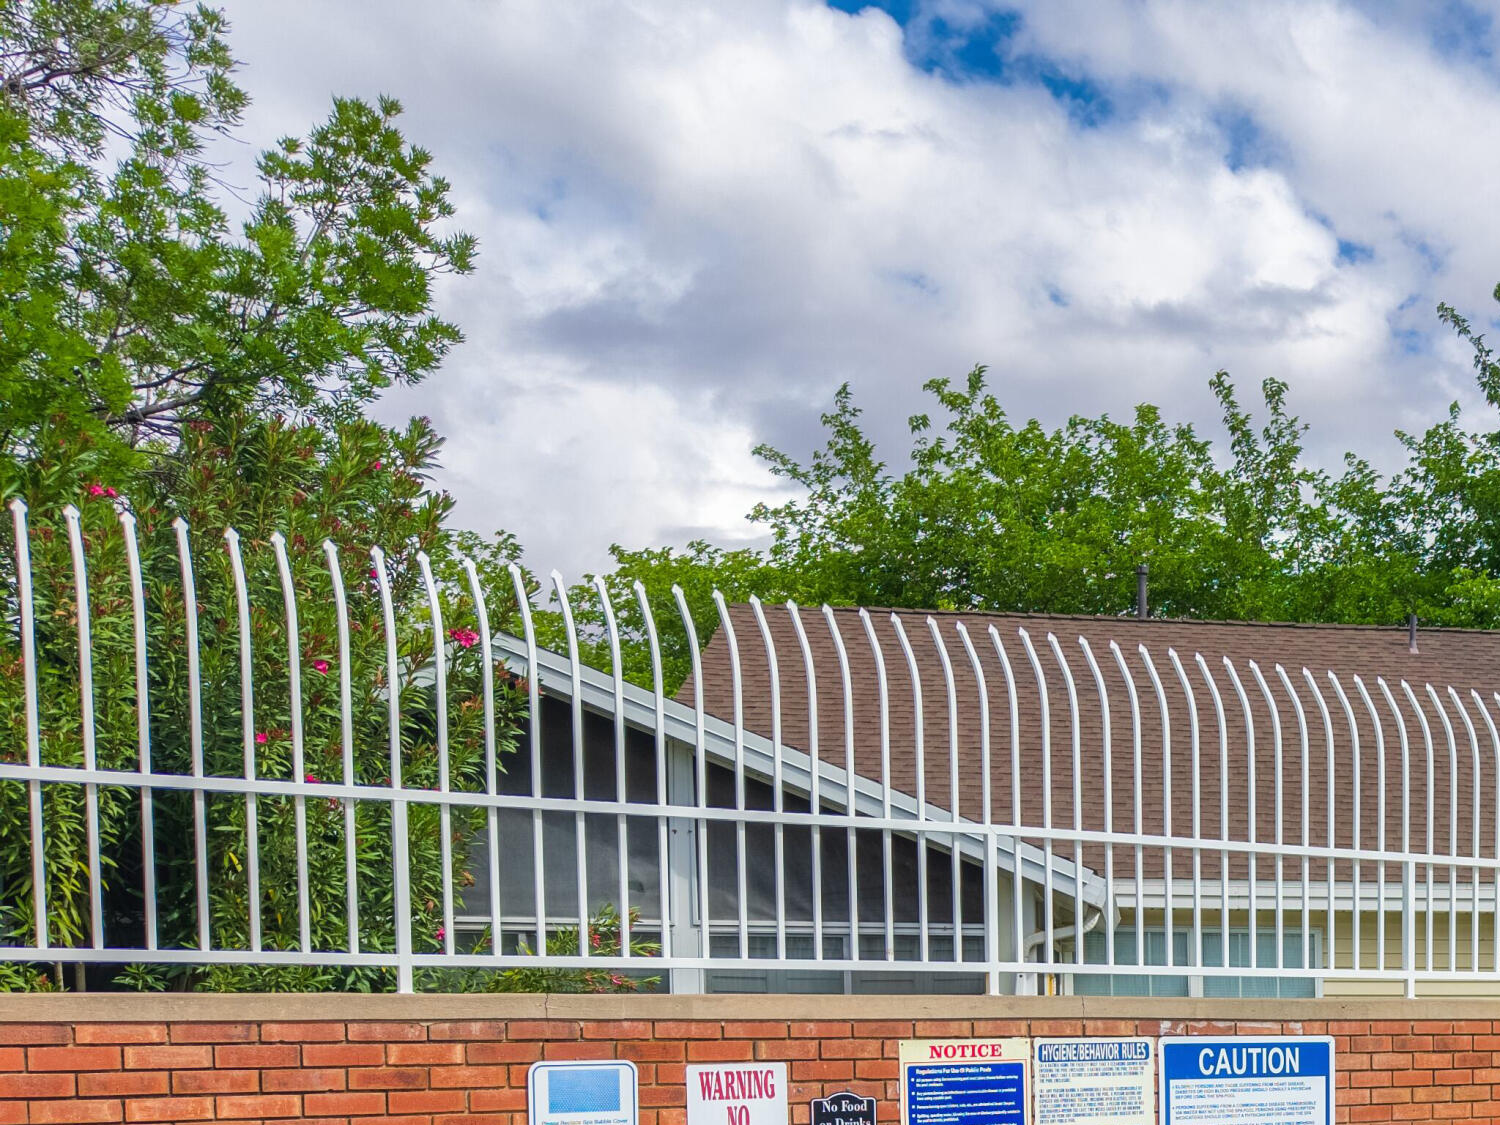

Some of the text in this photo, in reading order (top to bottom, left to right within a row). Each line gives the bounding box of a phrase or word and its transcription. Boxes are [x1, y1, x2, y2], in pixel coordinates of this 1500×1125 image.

[929, 1044, 1002, 1059] NOTICE
[1041, 1043, 1146, 1062] HYGIENE/BEHAVIOR RULES
[1198, 1047, 1300, 1075] CAUTION
[699, 1070, 775, 1100] WARNING
[822, 1100, 867, 1112] No Food
